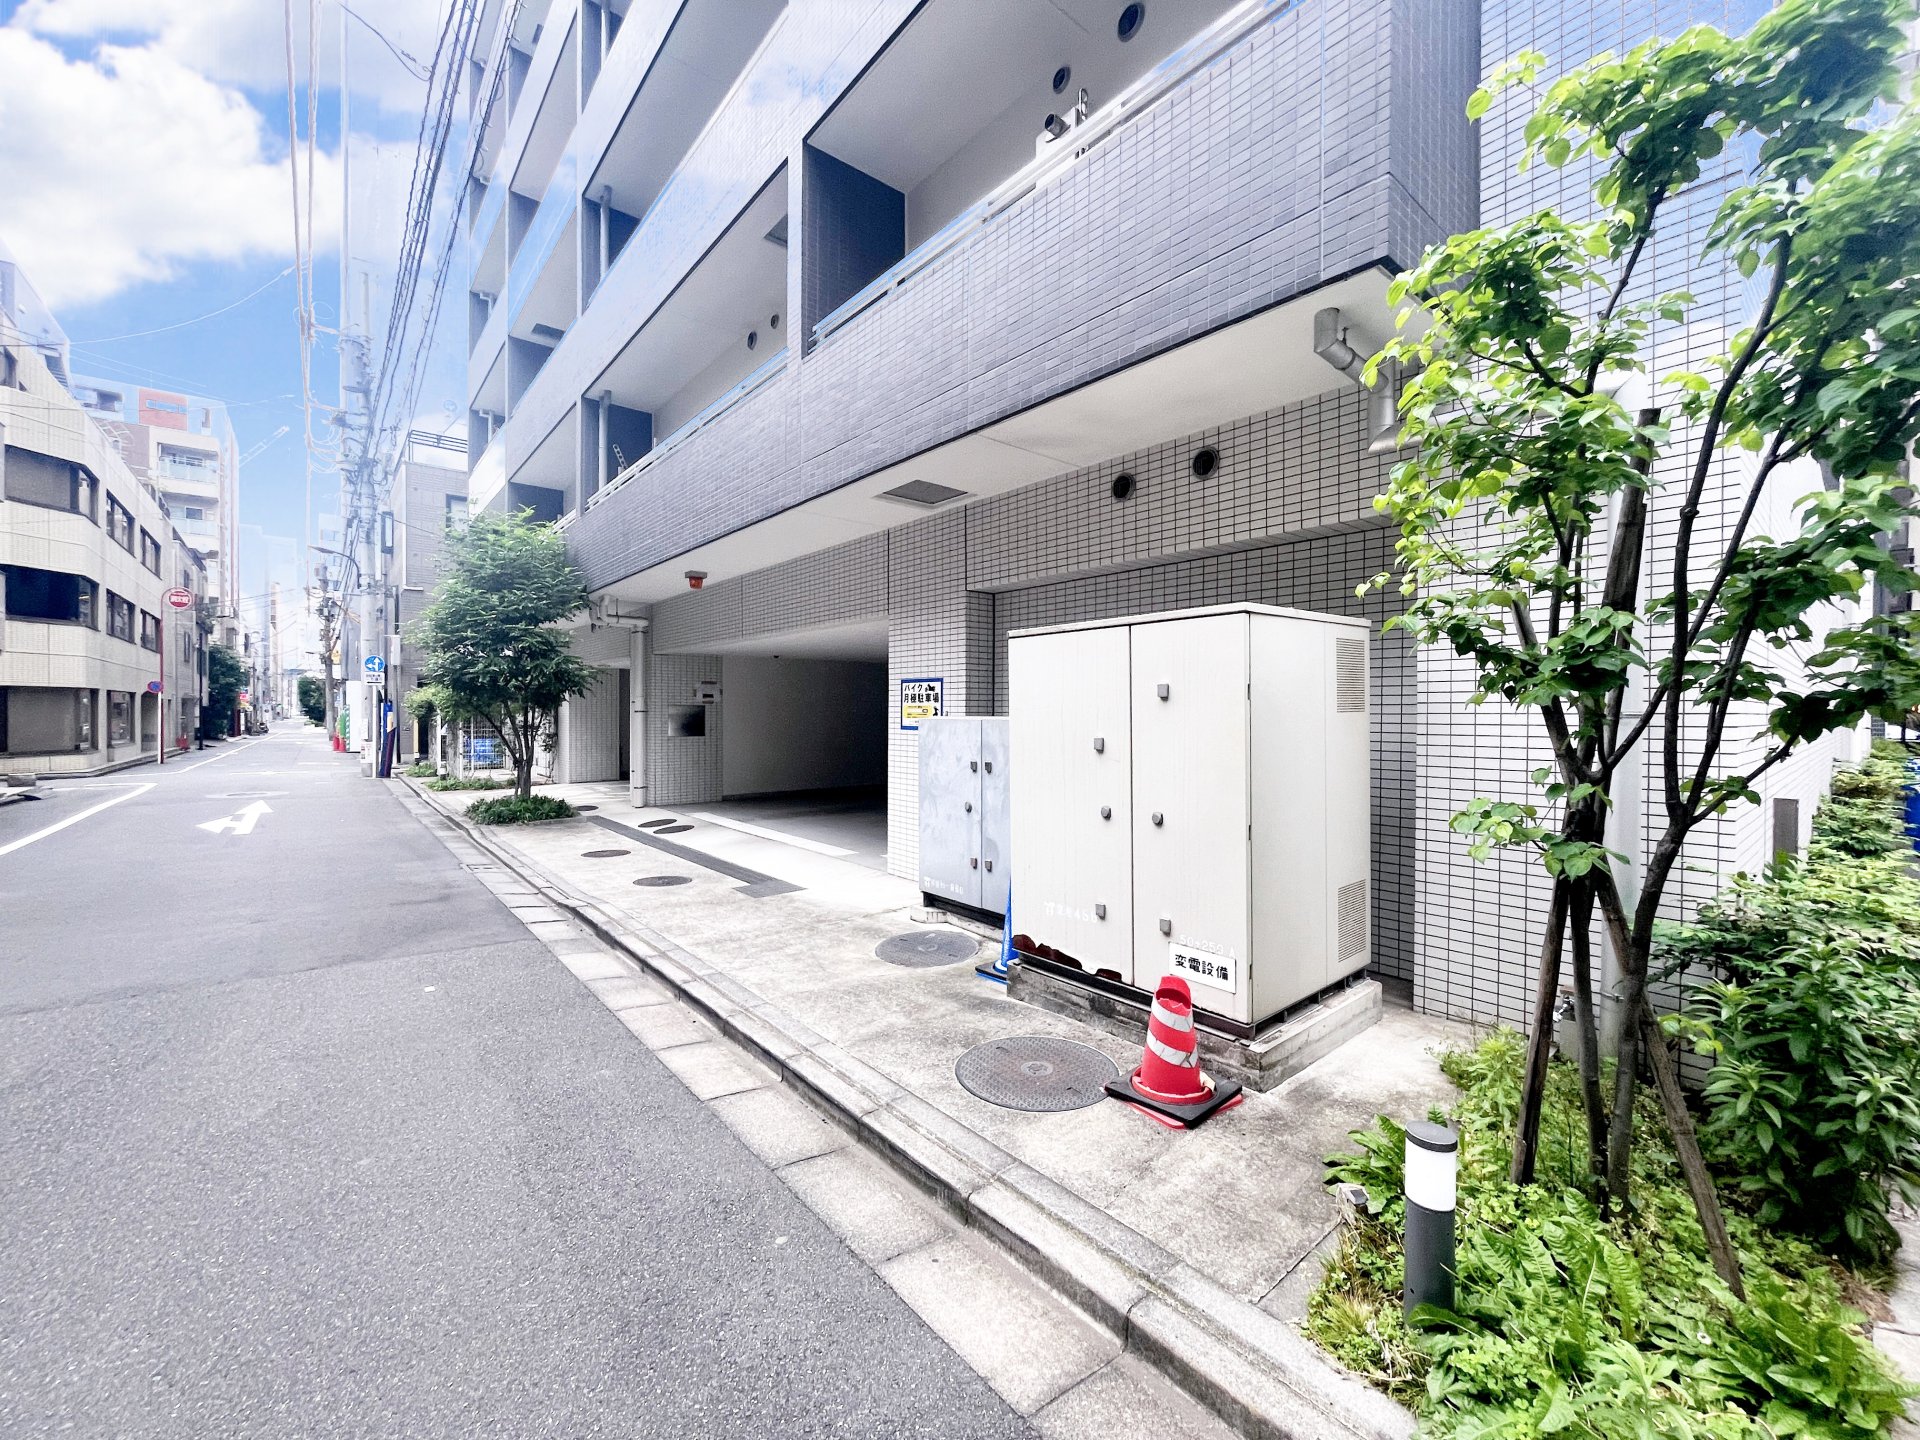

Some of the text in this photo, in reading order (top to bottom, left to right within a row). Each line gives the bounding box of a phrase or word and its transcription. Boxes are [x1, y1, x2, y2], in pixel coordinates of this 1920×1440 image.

[904, 692, 939, 703] 月極駐車場
[1175, 954, 1228, 981] 変電設備
